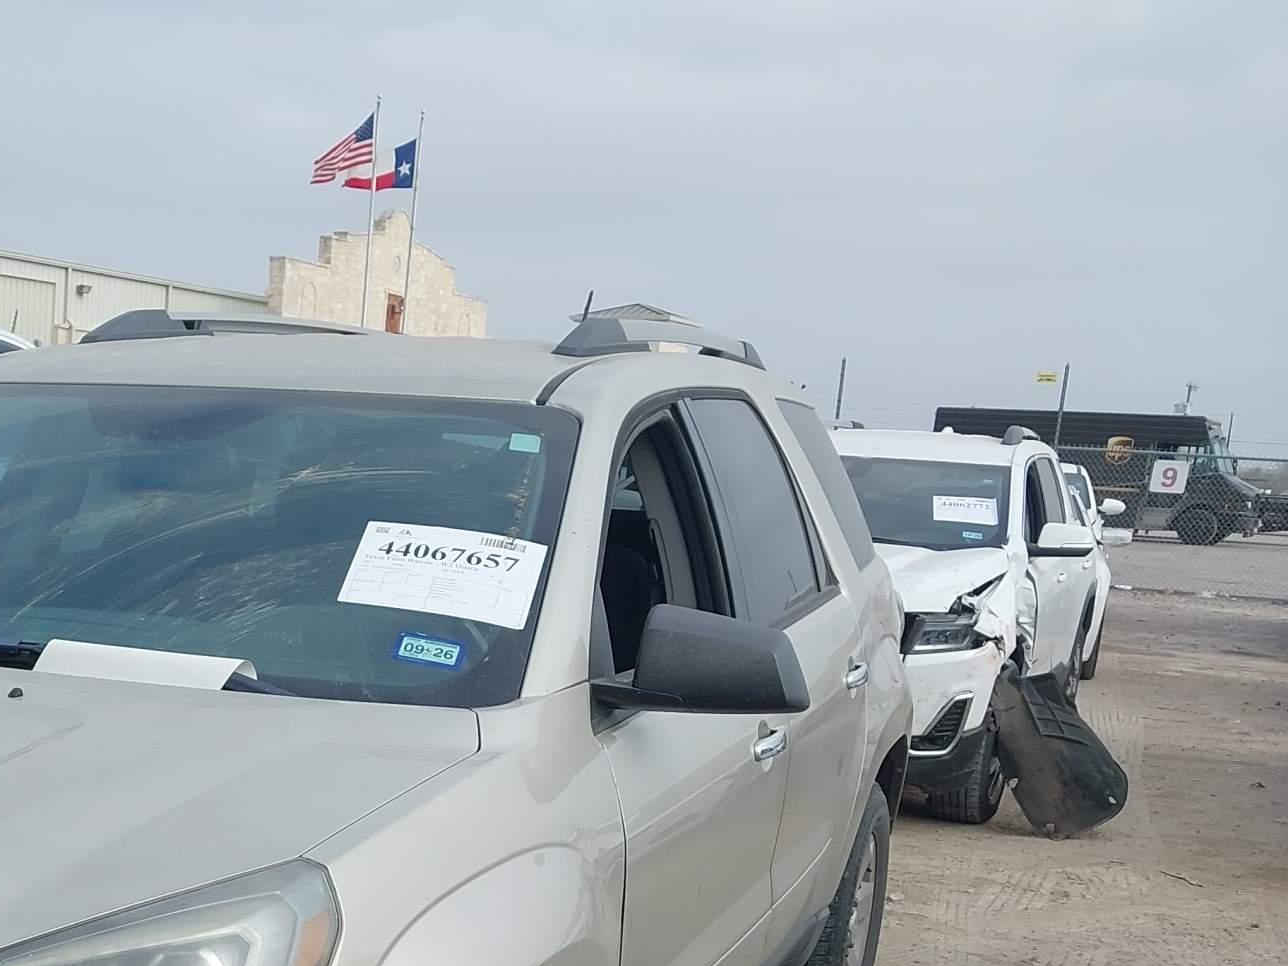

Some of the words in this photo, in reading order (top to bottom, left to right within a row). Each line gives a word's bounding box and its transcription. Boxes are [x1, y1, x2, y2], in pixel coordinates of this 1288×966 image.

[1161, 467, 1178, 488] 9
[377, 540, 521, 573] 44067657
[404, 642, 424, 655] 09
[433, 647, 454, 660] 26
